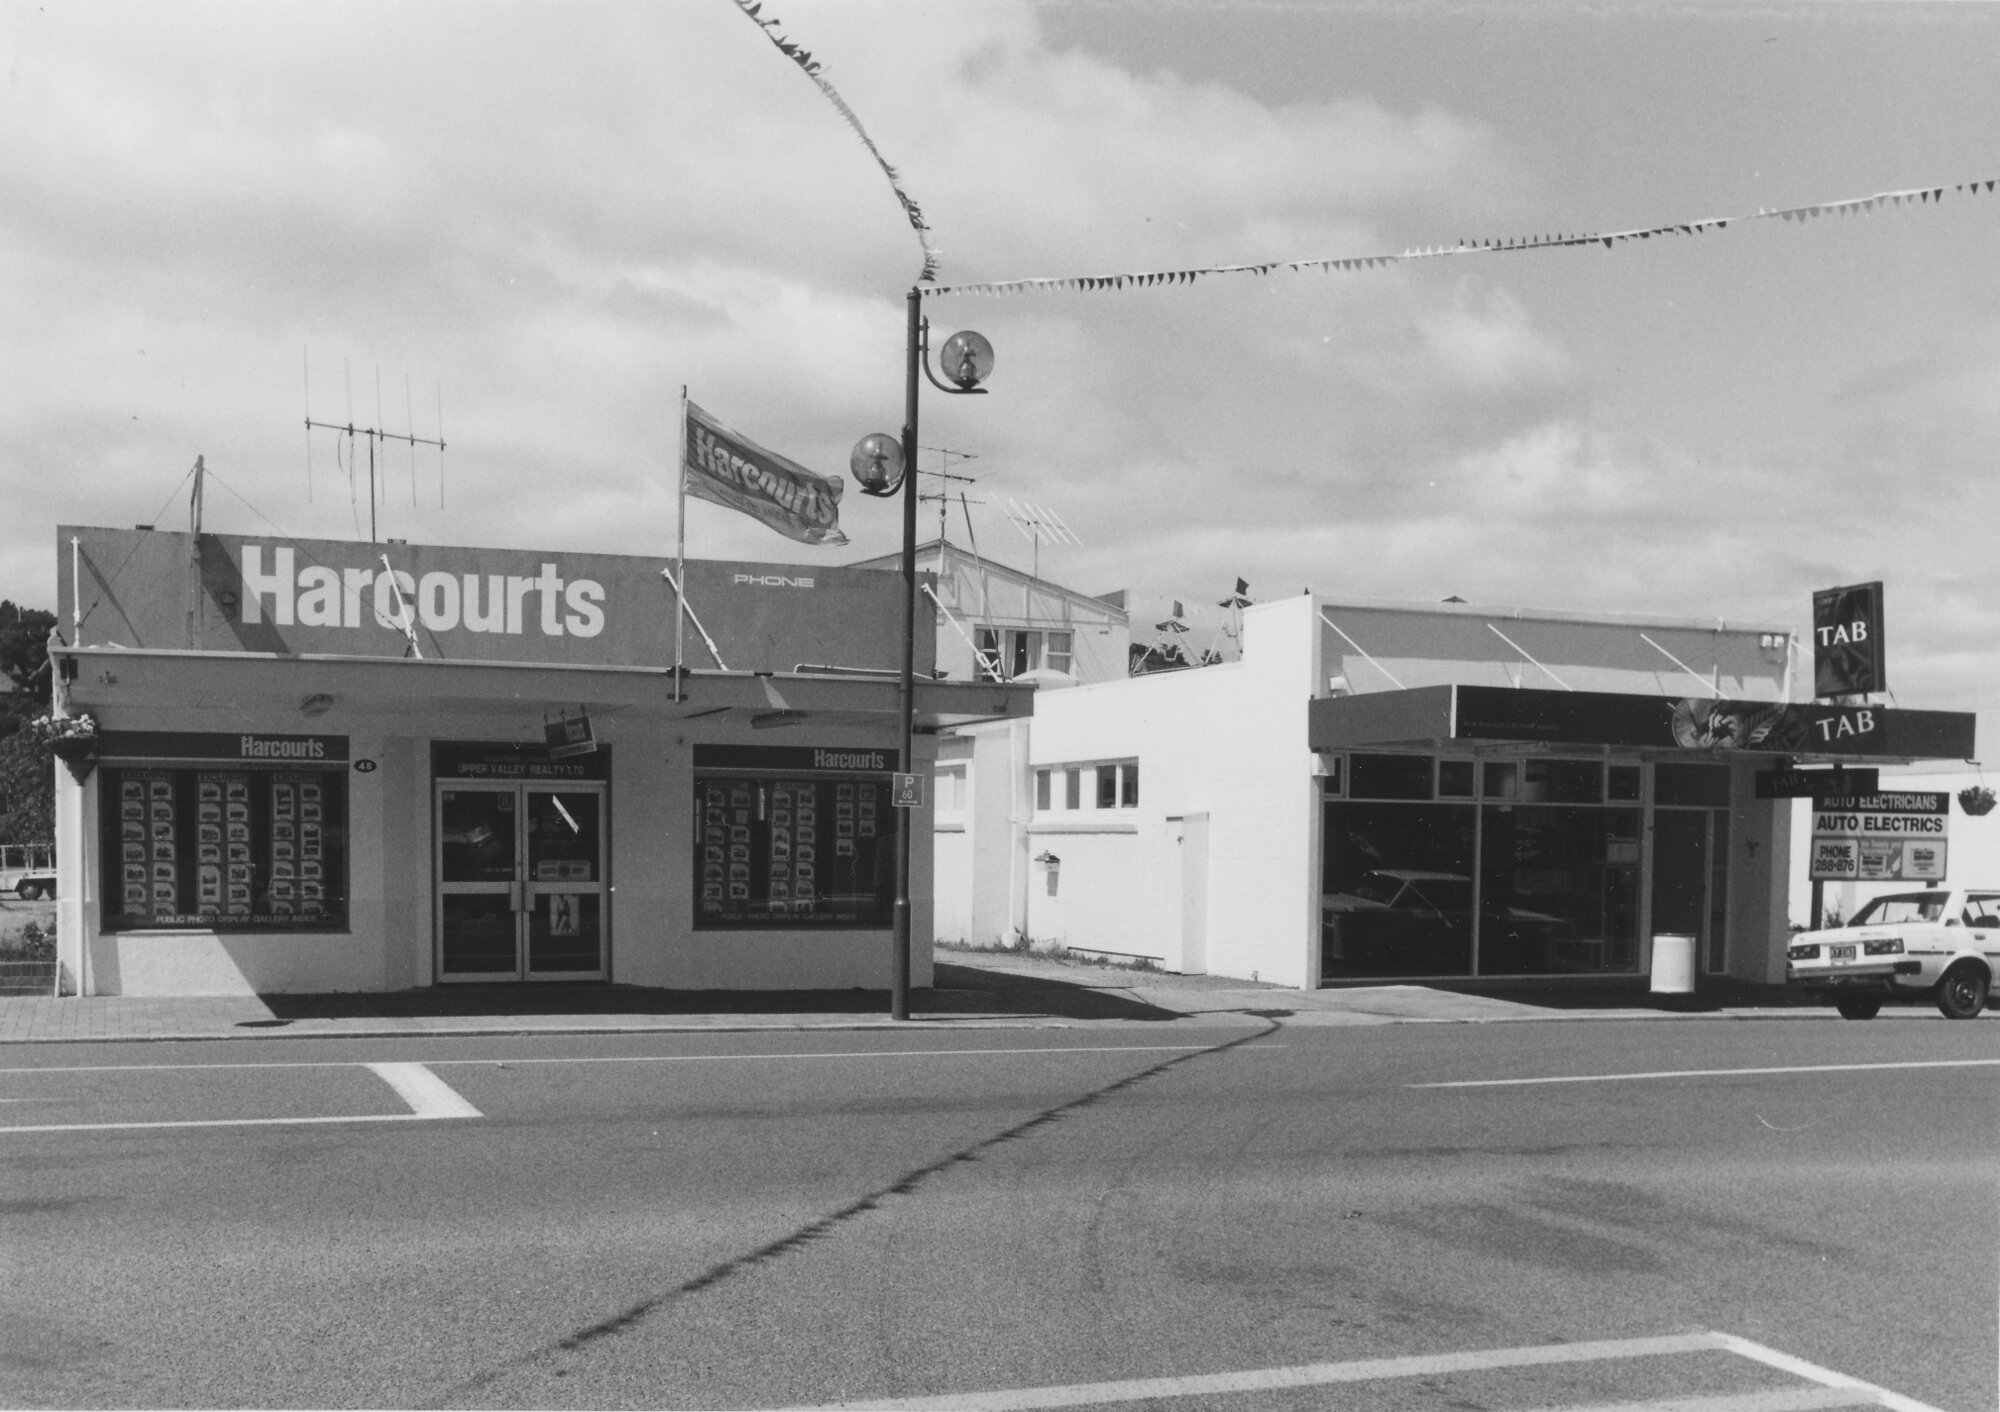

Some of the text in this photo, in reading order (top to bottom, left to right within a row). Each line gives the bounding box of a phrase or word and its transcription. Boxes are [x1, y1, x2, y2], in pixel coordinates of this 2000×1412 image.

[695, 426, 834, 524] Harcourts
[734, 574, 815, 588] PHONE
[241, 544, 605, 638] Harcourts
[1817, 620, 1868, 647] TAB
[1815, 709, 1875, 741] TAB
[241, 735, 324, 758] Harcourts
[358, 762, 373, 771] 48
[814, 749, 884, 769] Harcourts
[457, 763, 585, 775] UPPER VALLEY REALTY LTD
[904, 776, 915, 788] P
[902, 790, 913, 800] 60
[1859, 794, 1937, 810] ELECTRICIANS
[1817, 815, 1943, 832] AUTO ELECTRICS
[1819, 845, 1852, 859] PHONE
[1815, 859, 1855, 872] 288-876
[156, 915, 186, 924] PUBLIC
[187, 915, 215, 924] PHOTO
